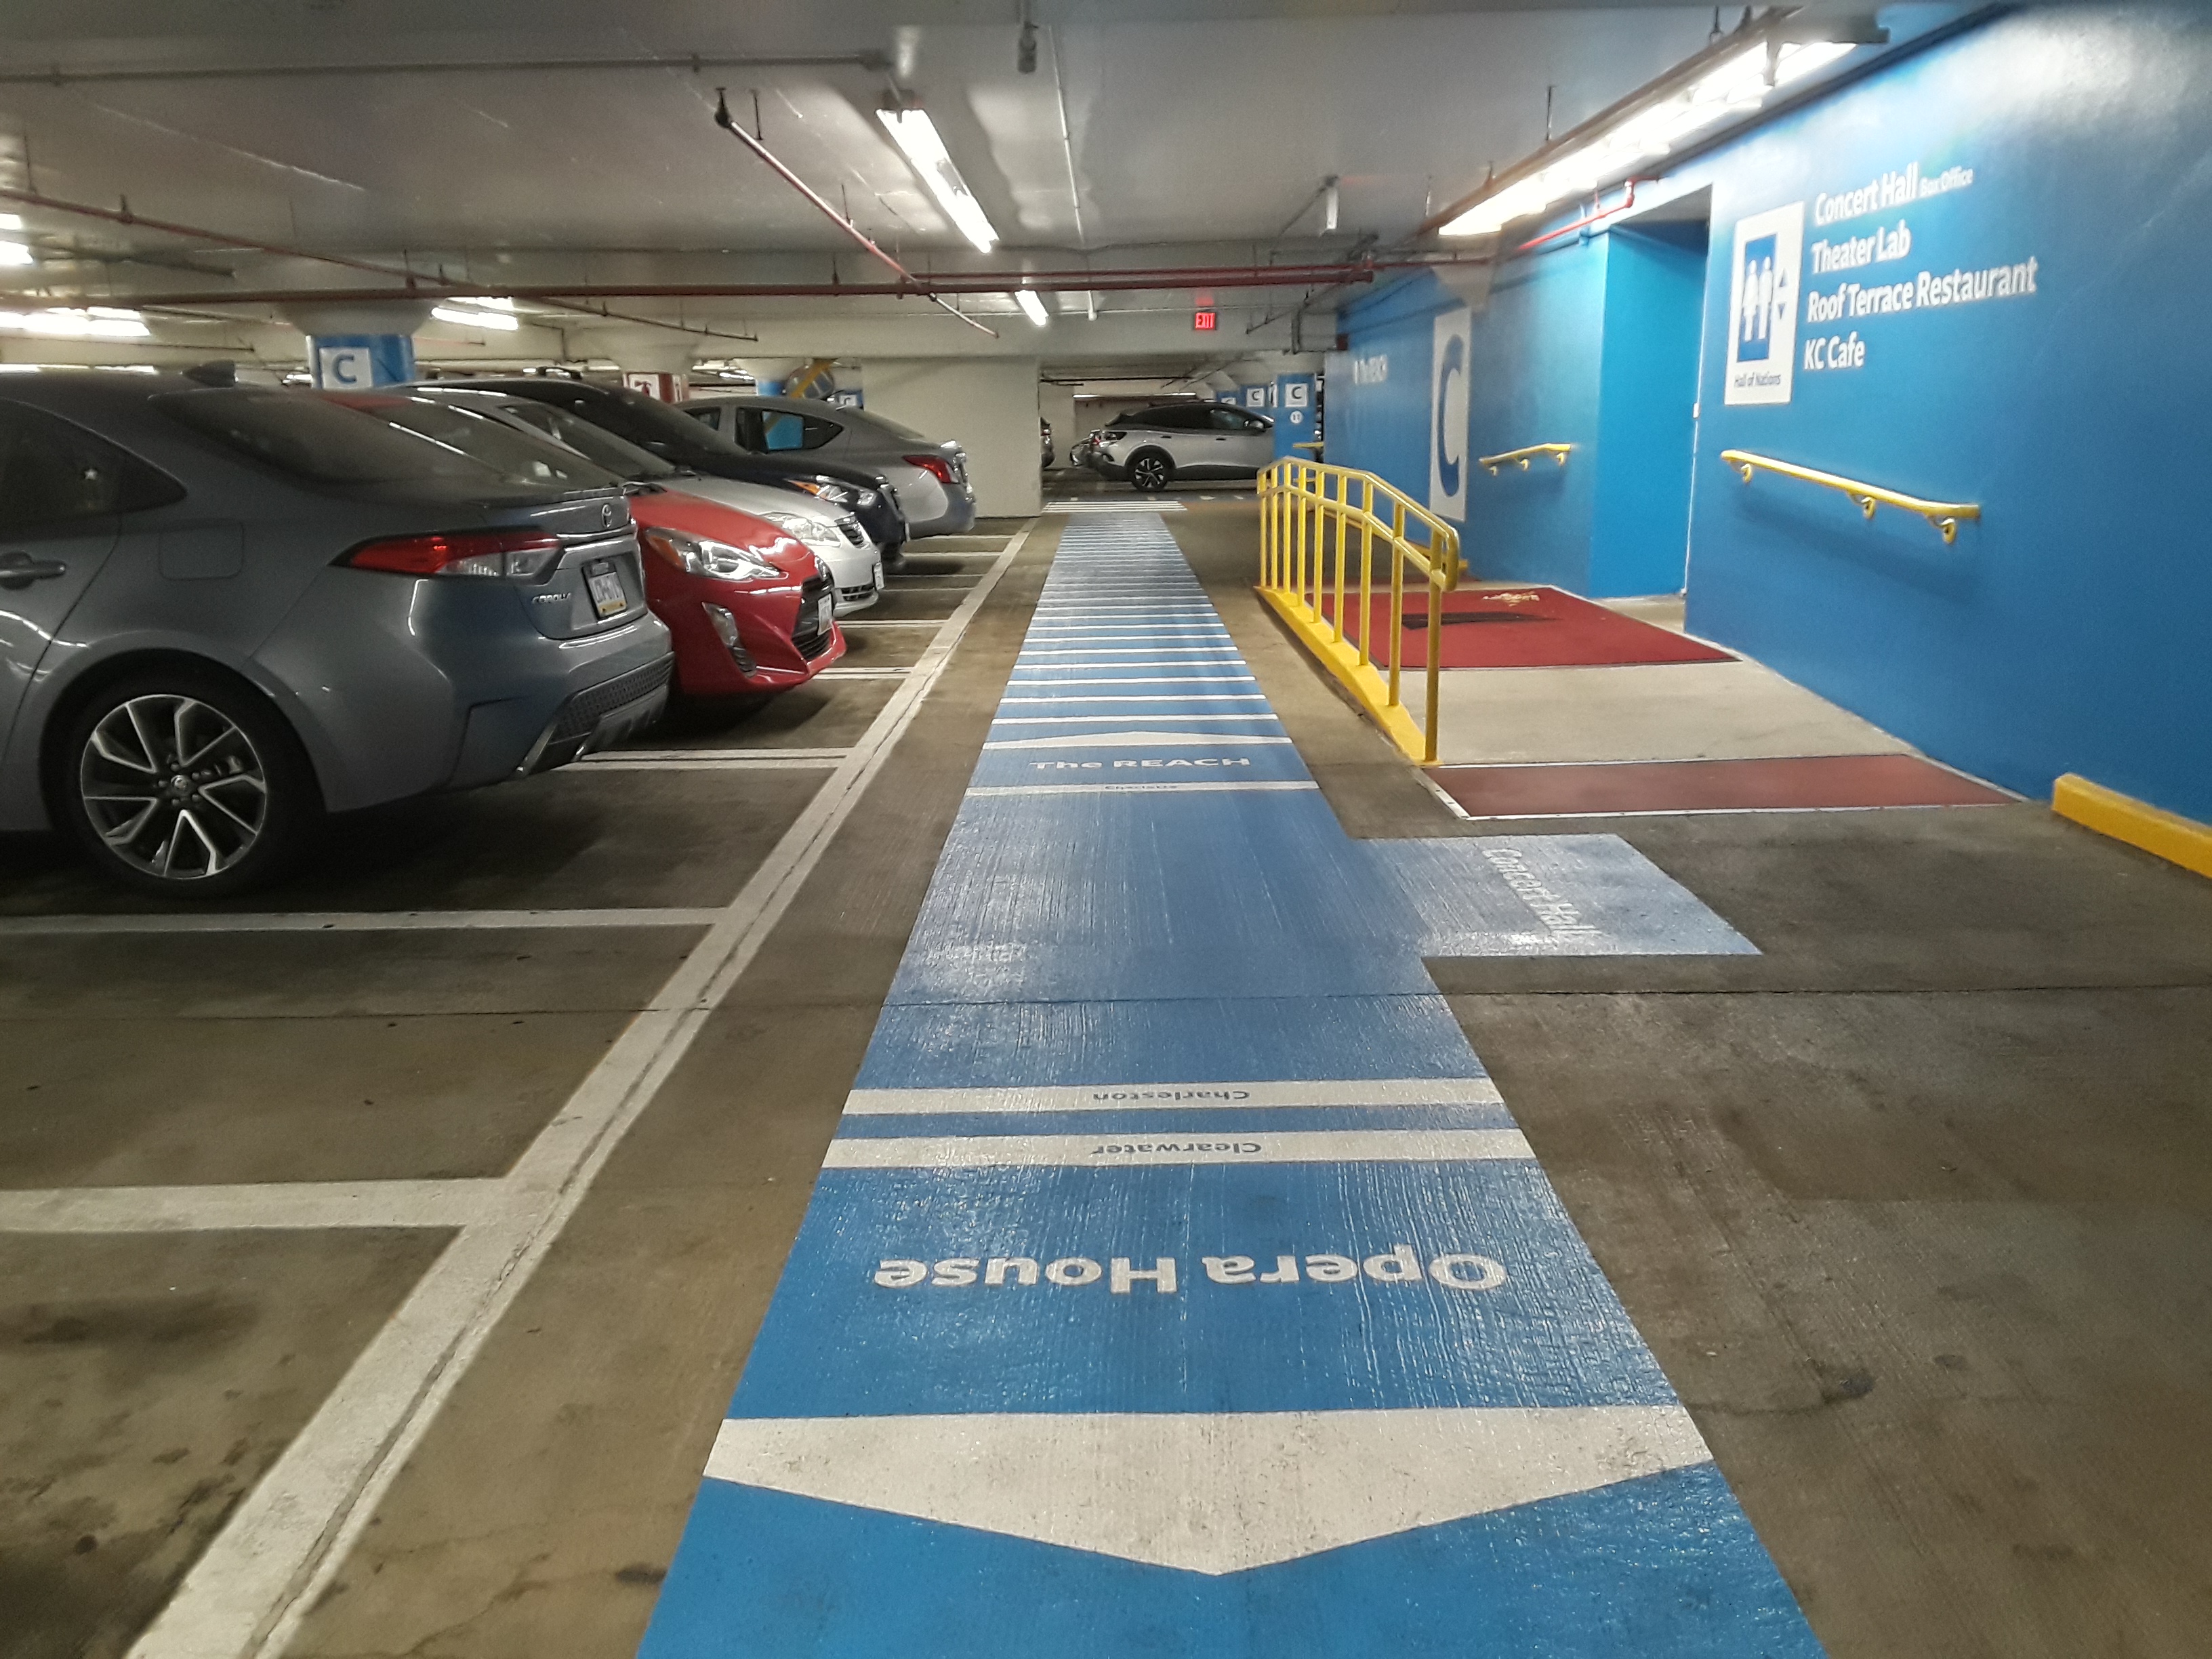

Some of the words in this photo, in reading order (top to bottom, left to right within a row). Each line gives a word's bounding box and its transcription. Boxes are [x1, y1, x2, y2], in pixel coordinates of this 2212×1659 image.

[1816, 178, 1879, 226] Concert
[1880, 161, 1920, 207] Hall
[1941, 166, 1974, 192] Office
[1811, 237, 1877, 274] Theater
[1876, 219, 1912, 262] Lab
[1807, 282, 1846, 323] Roof
[1846, 281, 1915, 316] Terrace
[1916, 255, 2039, 308] Restaurant
[1195, 313, 1214, 328] EXIT
[332, 353, 356, 384] C
[1804, 336, 1827, 369] KC
[1827, 331, 1866, 369] Cafe
[1292, 386, 1303, 400] C
[1439, 334, 1463, 498] C
[1028, 761, 1103, 770] The
[1113, 758, 1250, 769] REACH
[1092, 1090, 1250, 1101] Charleston
[1090, 1143, 1262, 1155] Clearwater
[873, 1255, 1178, 1294] House
[1204, 1244, 1508, 1291] Opera
